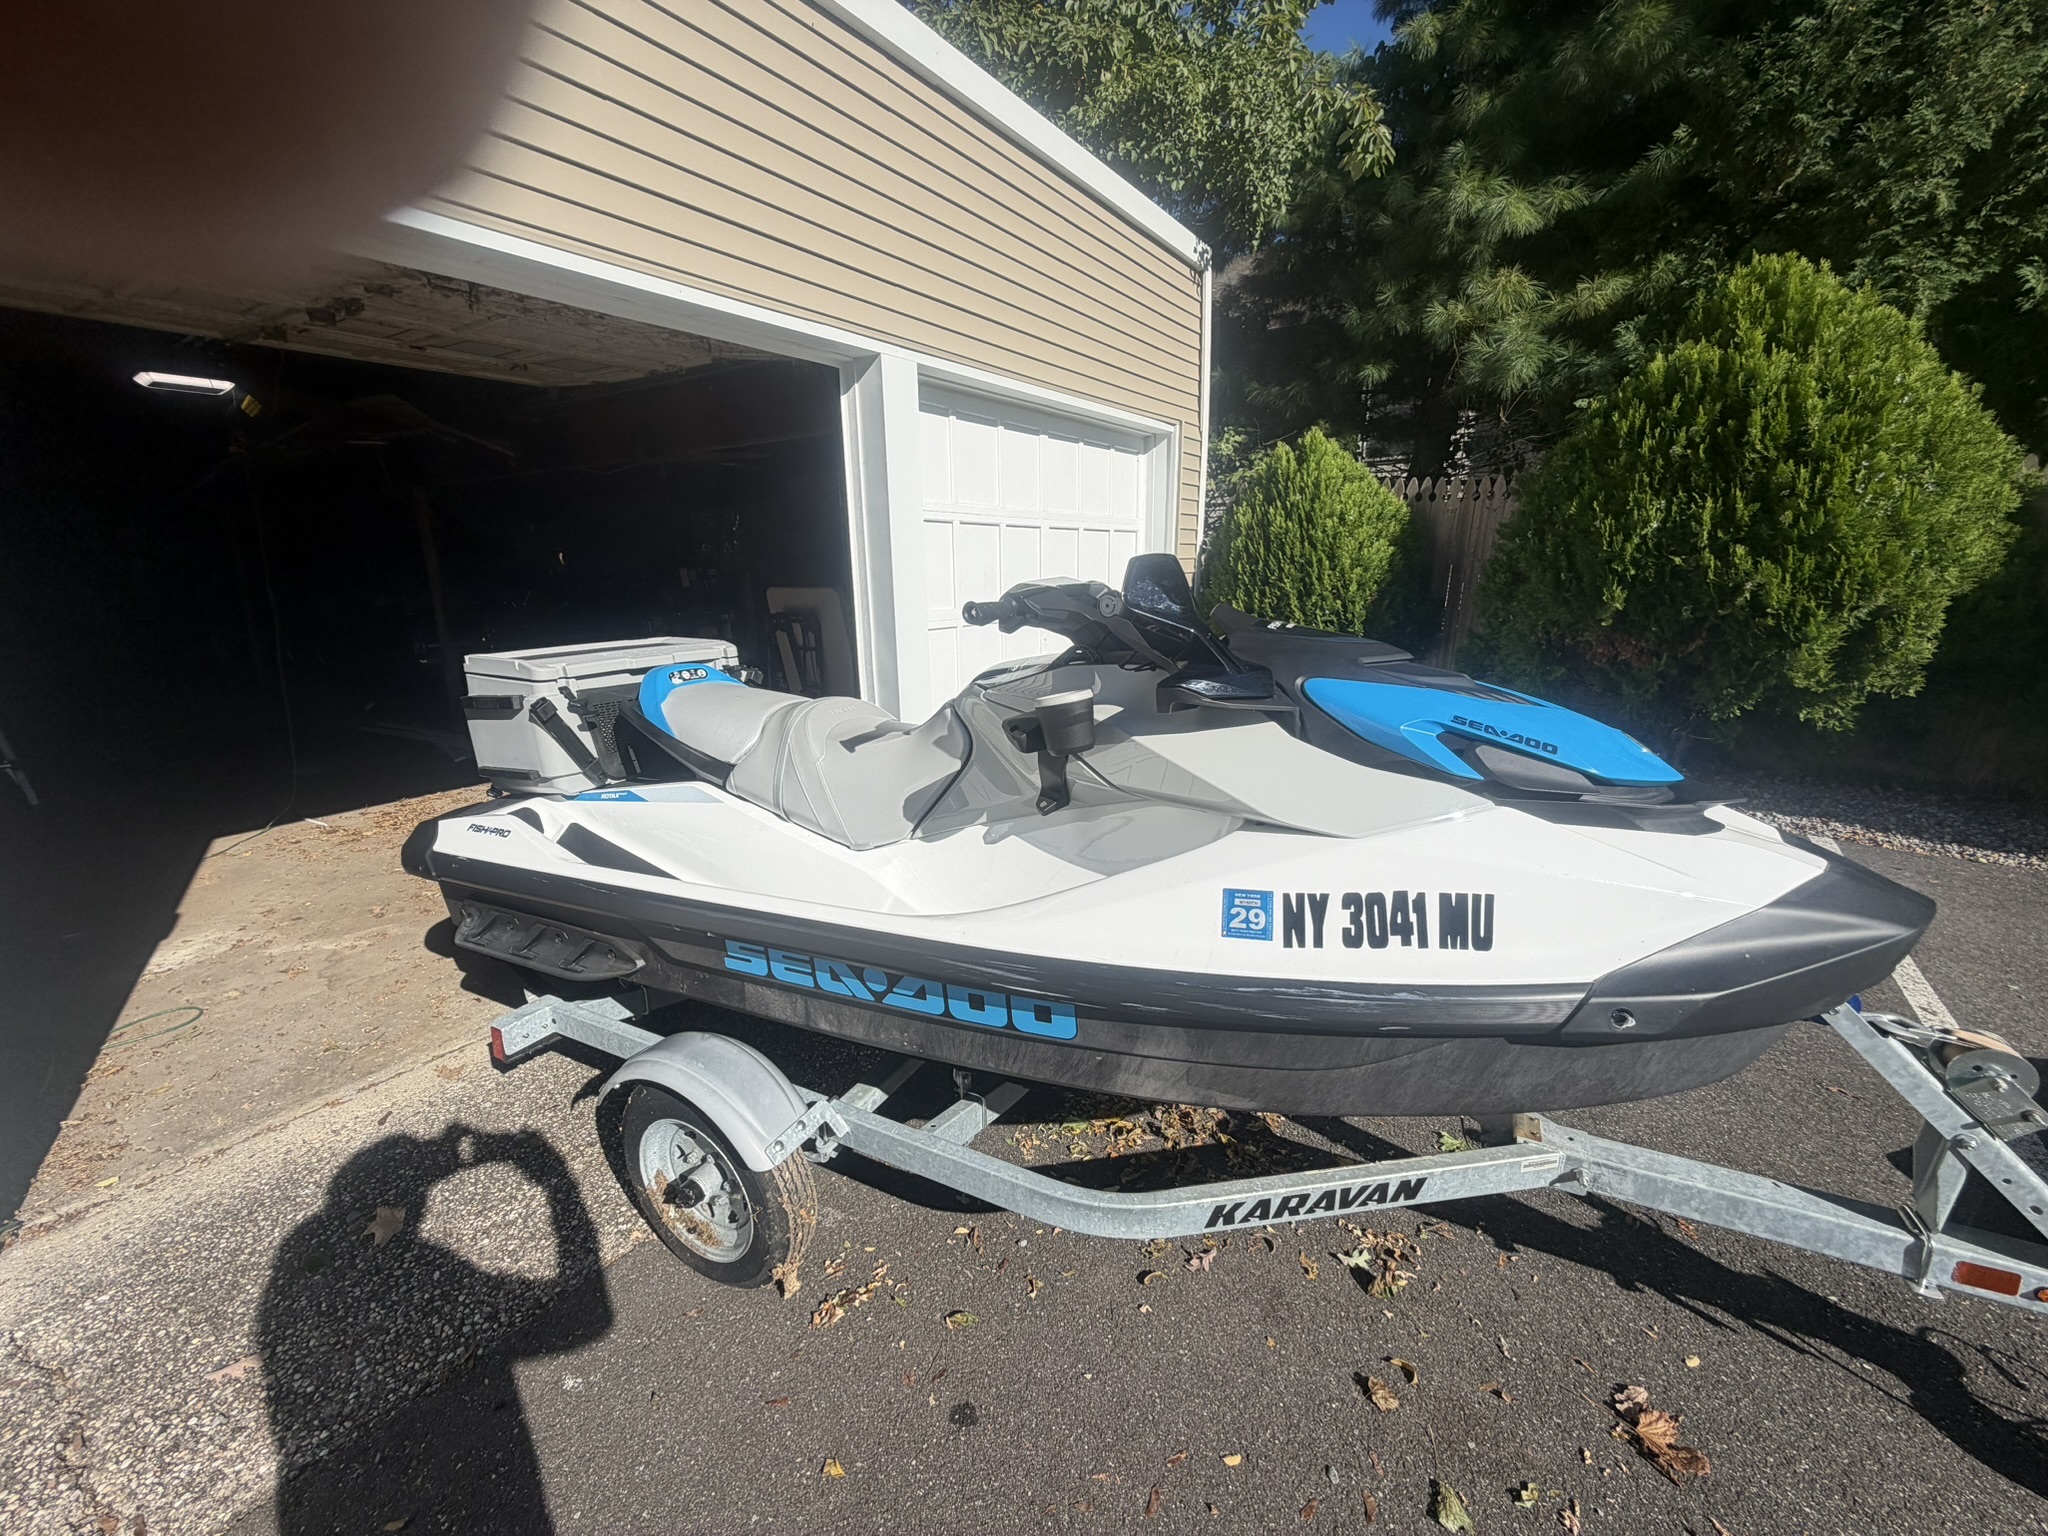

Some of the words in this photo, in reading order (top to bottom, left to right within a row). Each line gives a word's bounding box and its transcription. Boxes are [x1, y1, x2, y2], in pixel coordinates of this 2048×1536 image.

[1229, 907, 1266, 930] 29
[1282, 892, 1330, 949] NY
[1341, 890, 1429, 949] 3041
[1438, 892, 1495, 952] MU
[1204, 1177, 1428, 1229] KARAVAN
